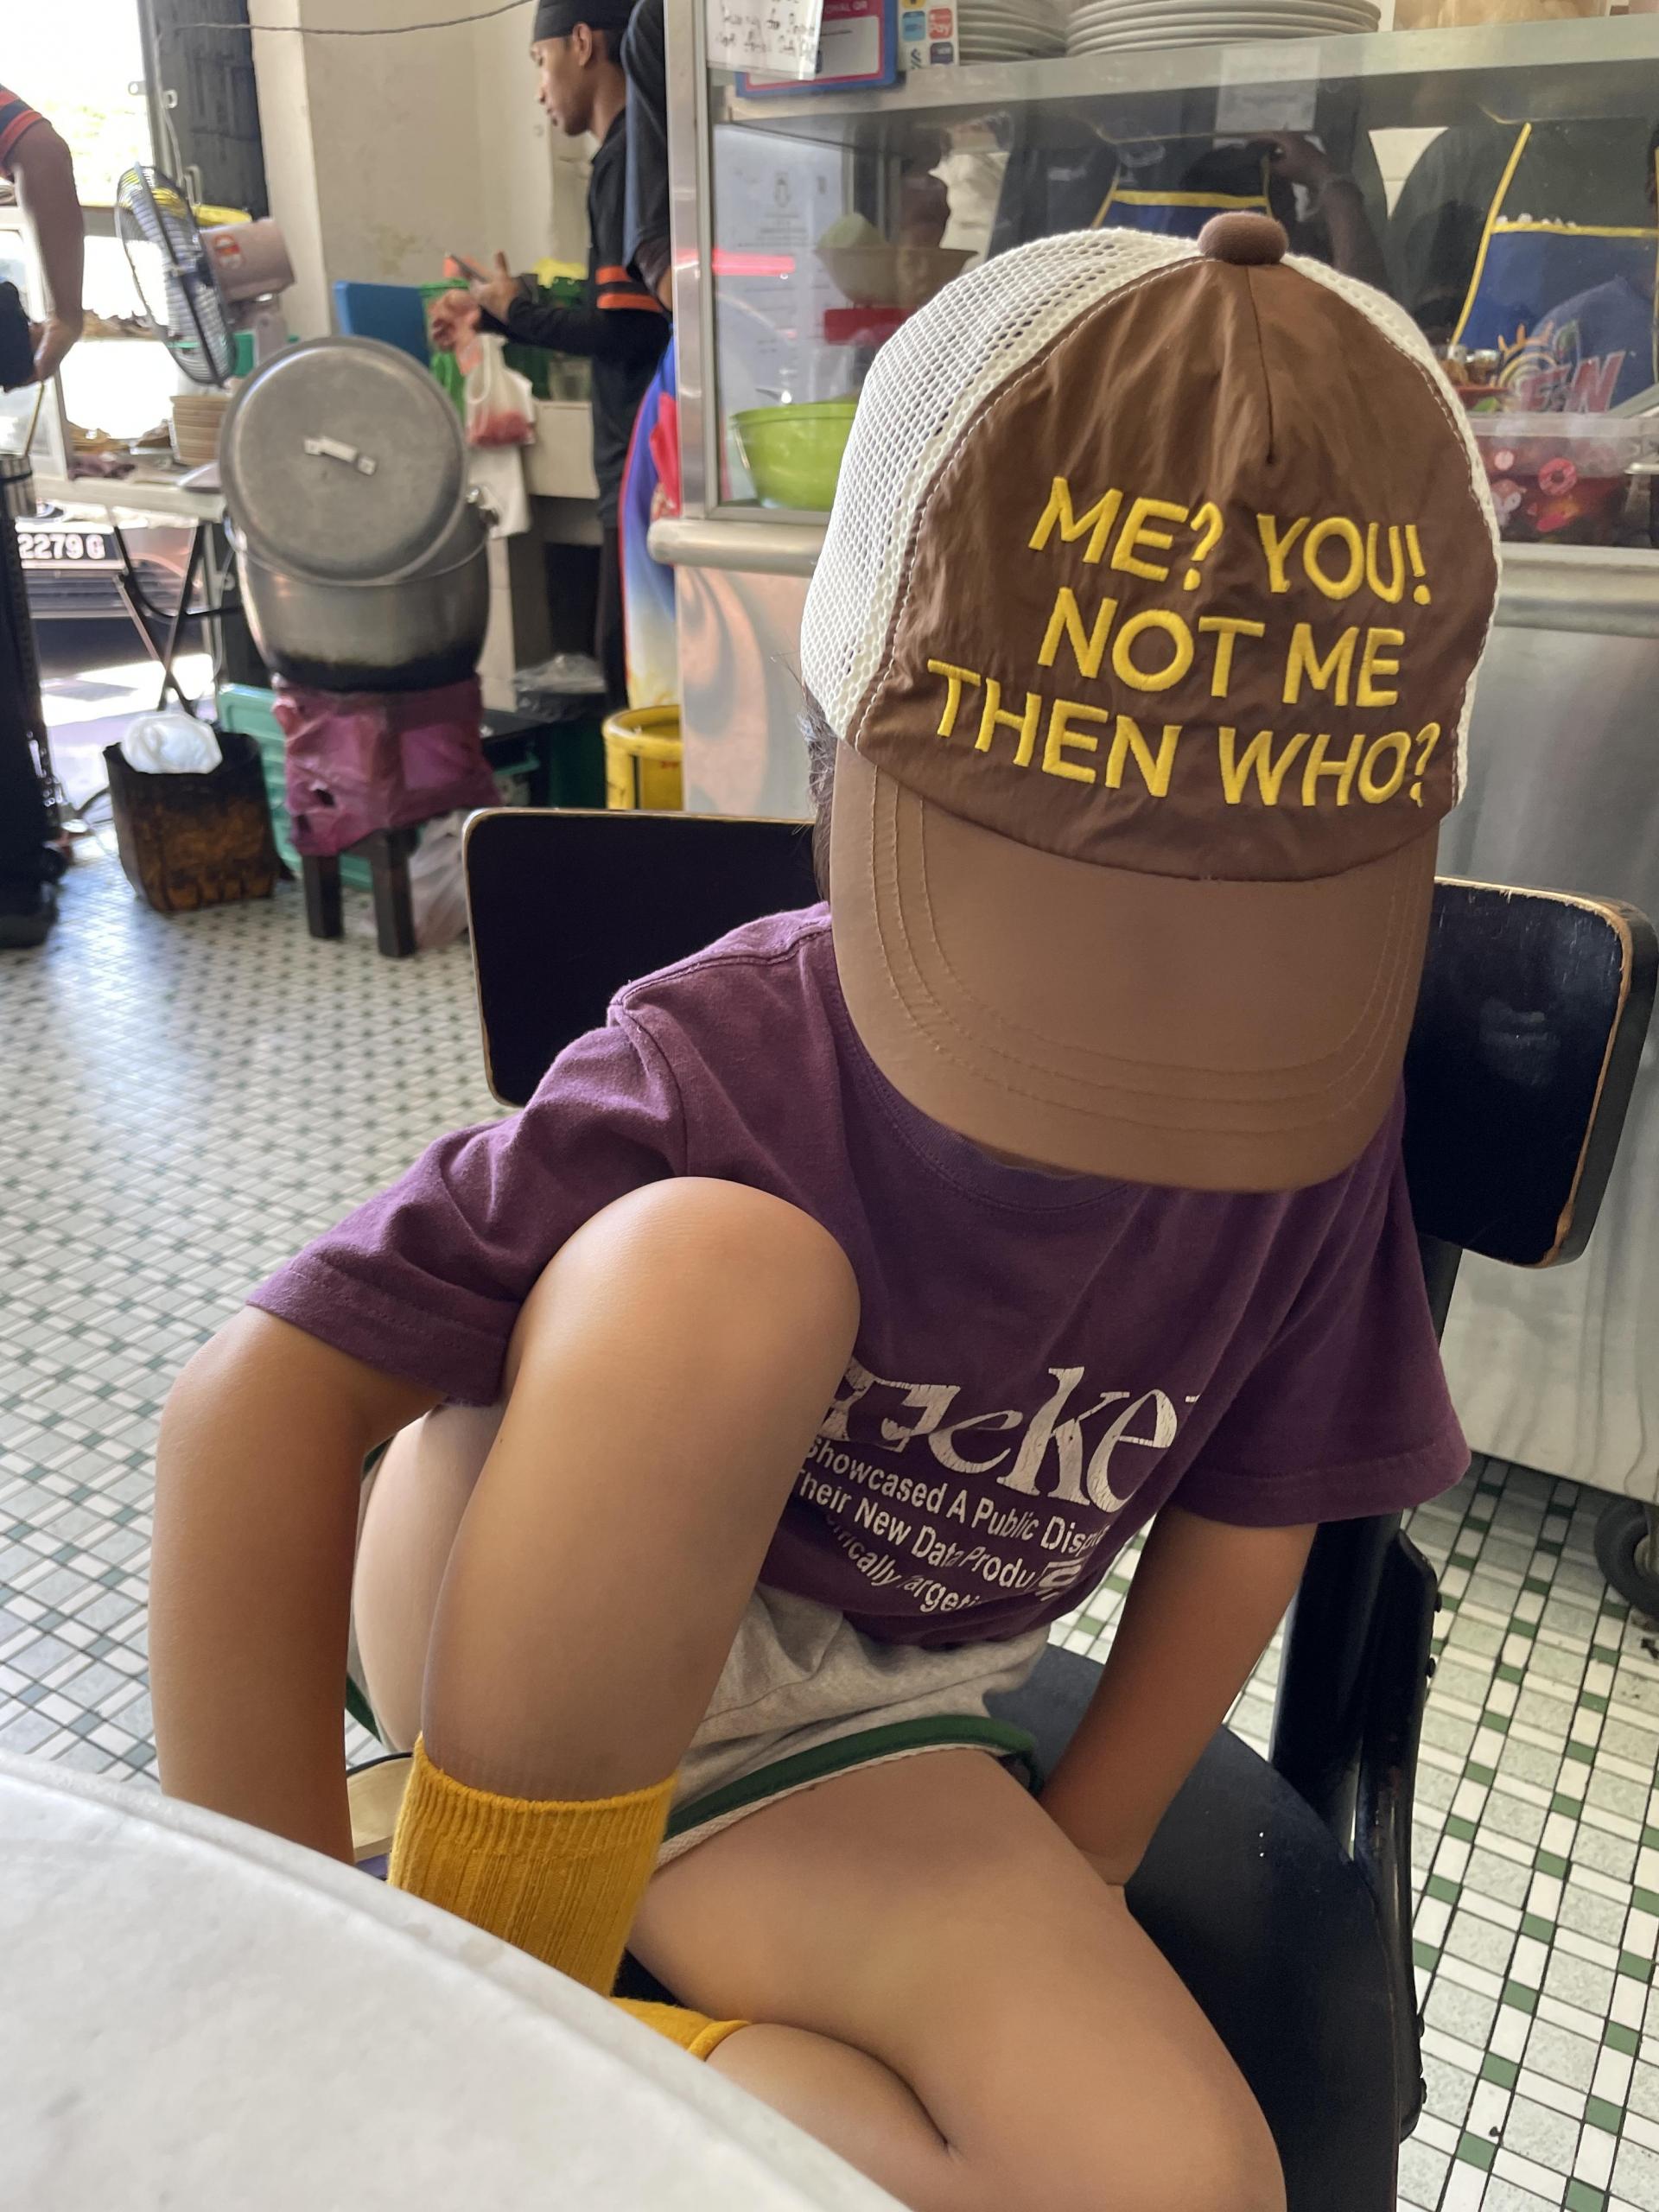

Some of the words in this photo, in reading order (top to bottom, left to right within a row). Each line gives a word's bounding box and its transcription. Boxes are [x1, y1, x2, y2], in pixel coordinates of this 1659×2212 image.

[1028, 476, 1224, 591] ME?
[1256, 512, 1432, 606] YOU!
[1037, 586, 1266, 698] NOT
[1282, 622, 1406, 708] ME
[927, 658, 1184, 798] THEN
[1218, 721, 1441, 808] WHO?
[799, 1469, 852, 1514] heir
[854, 1497, 912, 1546] New
[958, 1546, 1036, 1589] Produ
[946, 1489, 968, 1523] A
[971, 1497, 1039, 1541] Public
